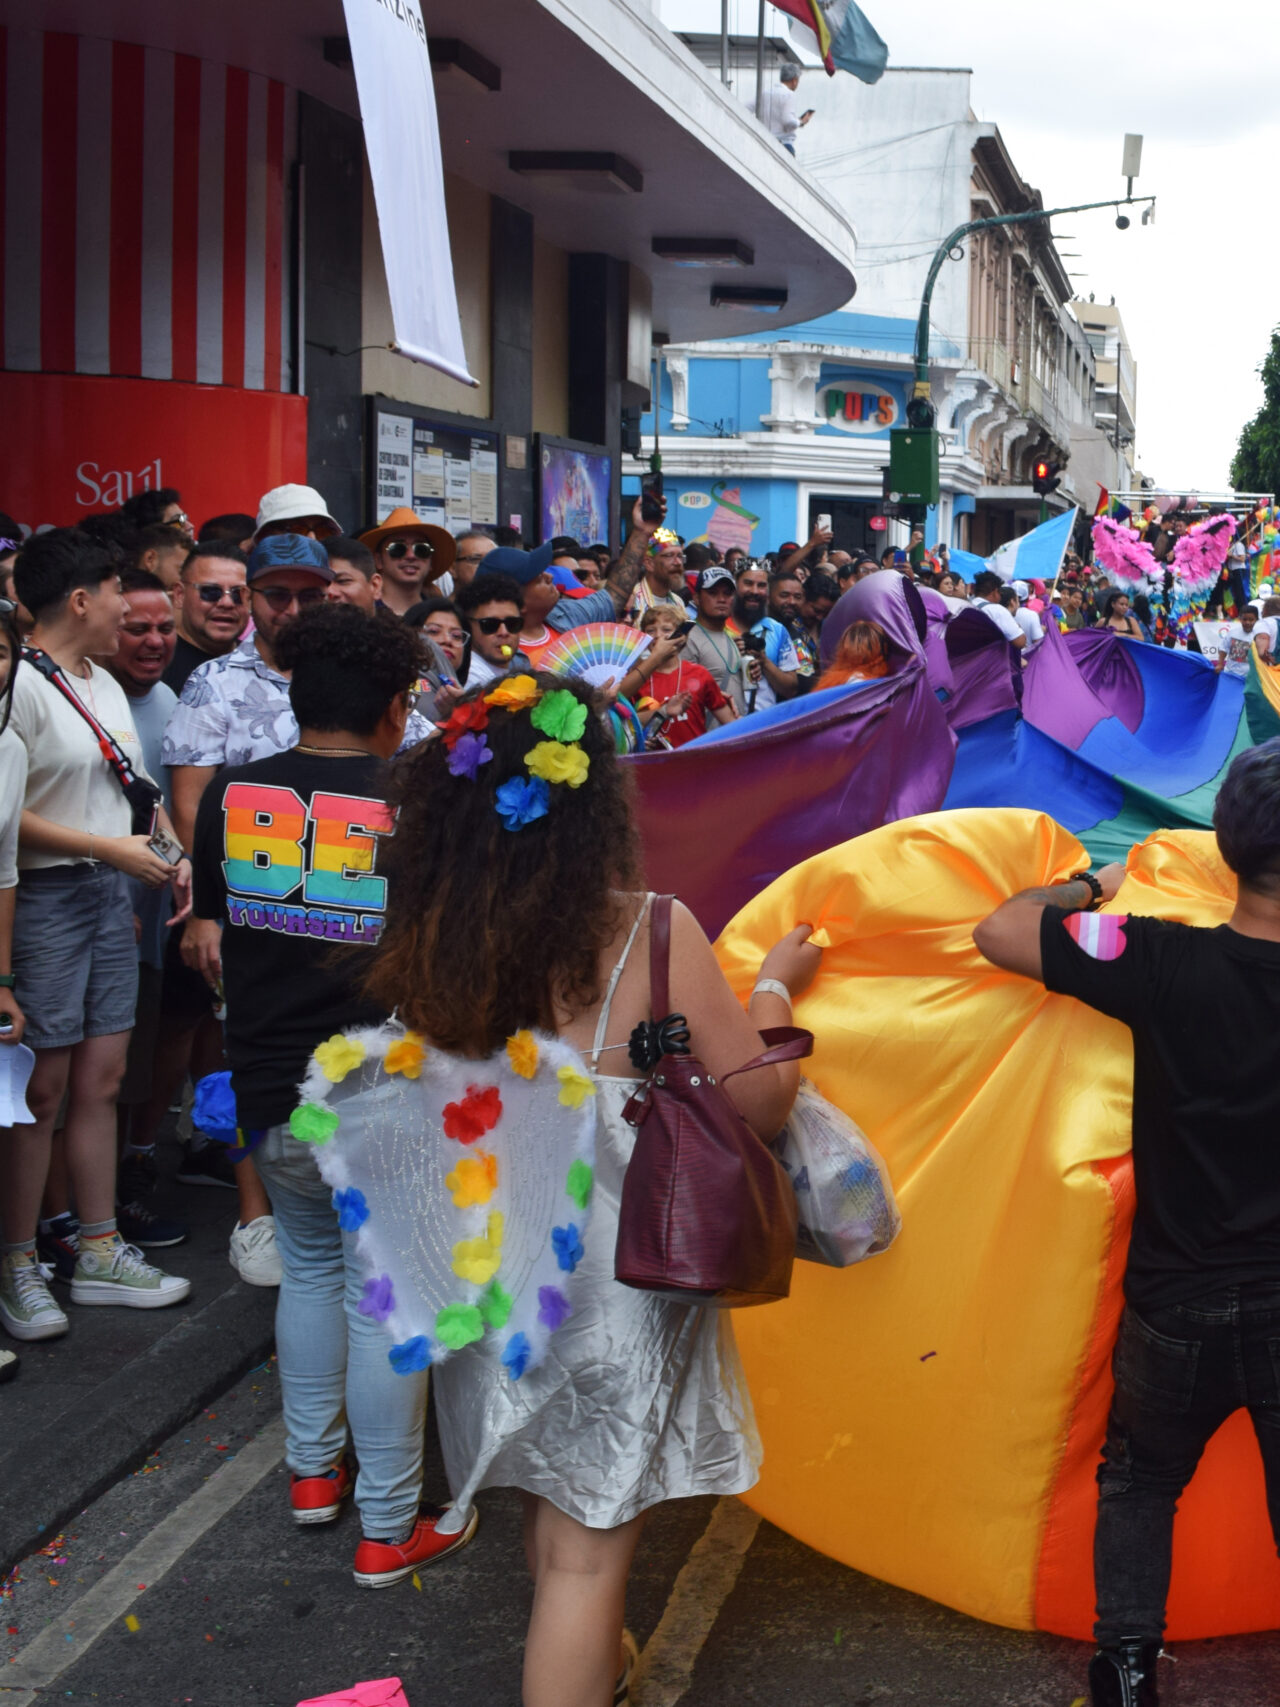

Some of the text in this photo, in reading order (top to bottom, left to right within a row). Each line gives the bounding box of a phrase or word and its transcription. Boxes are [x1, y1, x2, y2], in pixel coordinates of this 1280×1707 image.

[825, 389, 894, 425] POPS
[75, 458, 162, 506] Saúl
[683, 495, 708, 505] POPS
[221, 782, 401, 912] BE
[226, 894, 387, 946] YOURSELF
